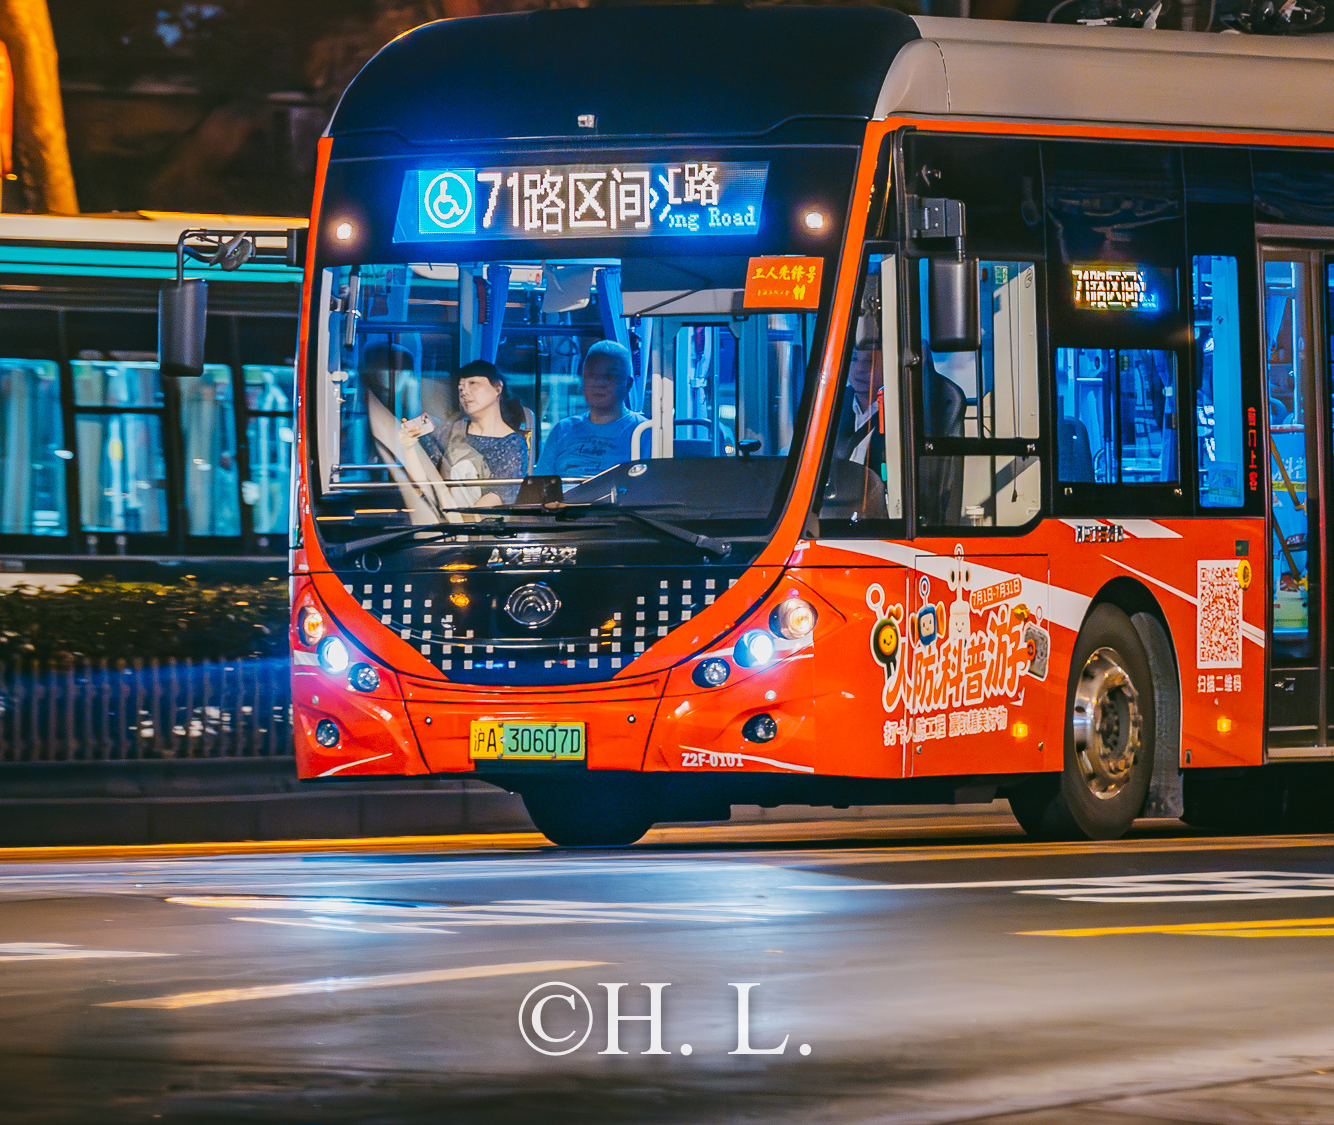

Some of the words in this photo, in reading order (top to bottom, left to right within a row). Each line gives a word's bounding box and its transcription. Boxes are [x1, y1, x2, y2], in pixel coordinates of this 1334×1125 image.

[476, 168, 651, 233] 71路区间
[708, 205, 757, 228] Road
[1197, 673, 1242, 693] 扫描二维码
[681, 752, 745, 768] Z2F-0101
